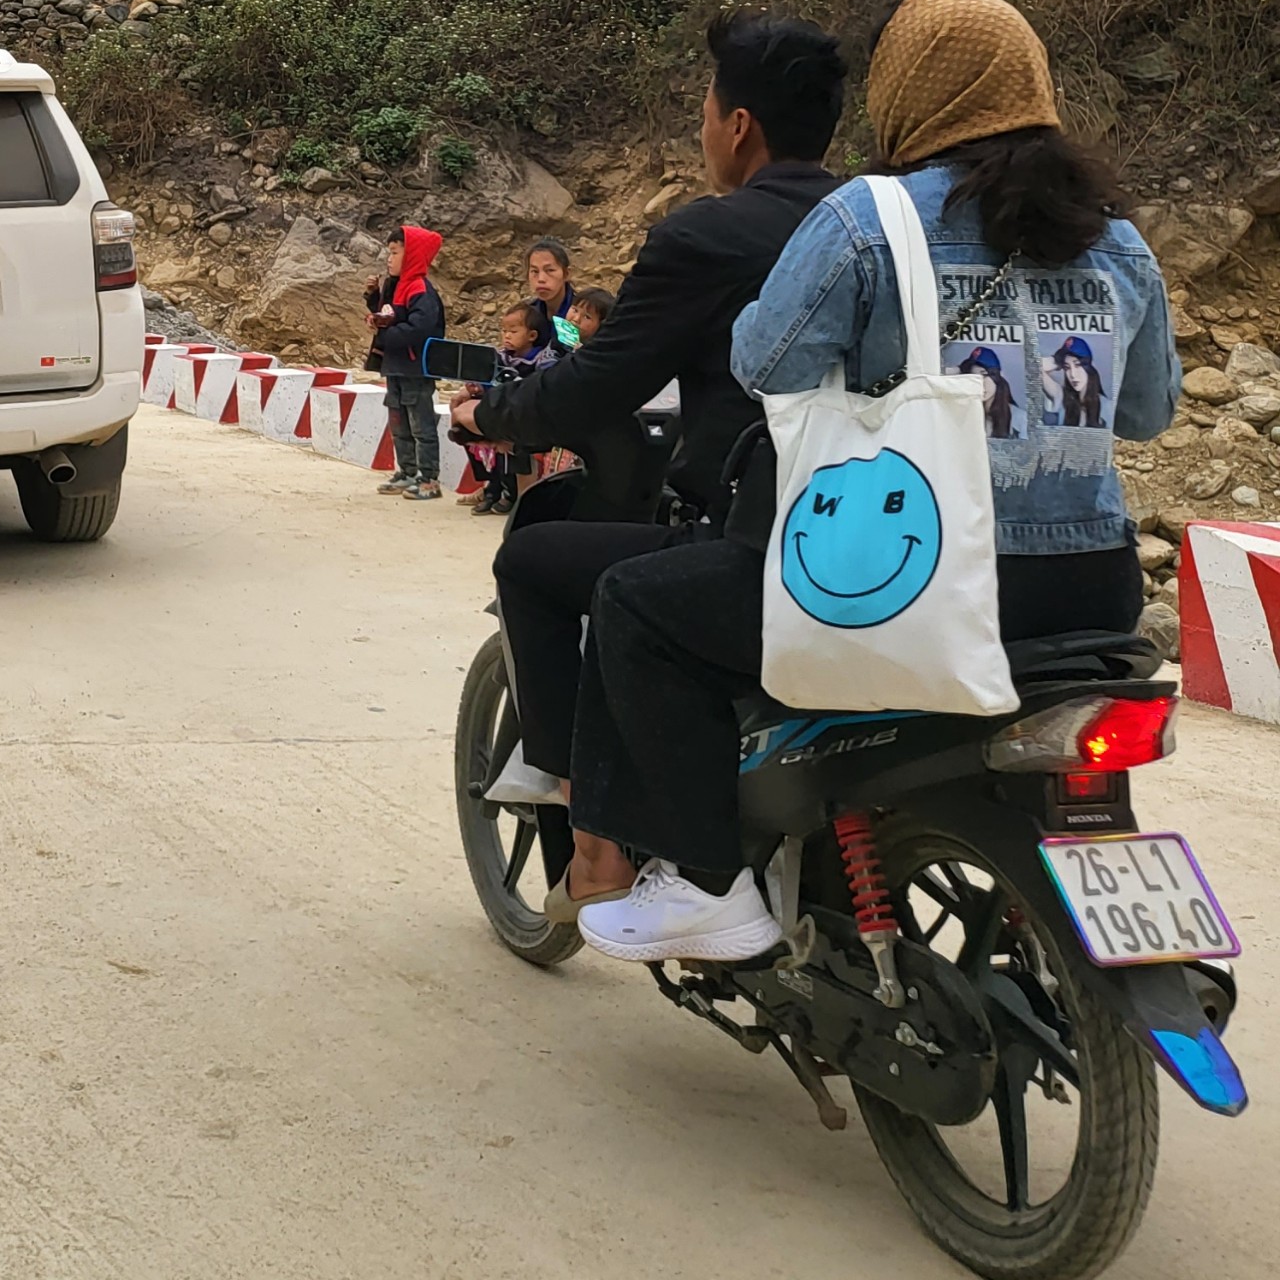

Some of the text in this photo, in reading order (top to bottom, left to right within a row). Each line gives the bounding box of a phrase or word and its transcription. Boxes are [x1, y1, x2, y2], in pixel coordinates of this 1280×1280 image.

[1023, 276, 1114, 305] TAILOR
[1037, 313, 1111, 333] BRUTAL
[813, 490, 905, 517] W B
[1066, 814, 1113, 823] HONDA
[1065, 842, 1180, 896] 26-L1
[1085, 897, 1223, 955] 196.40
